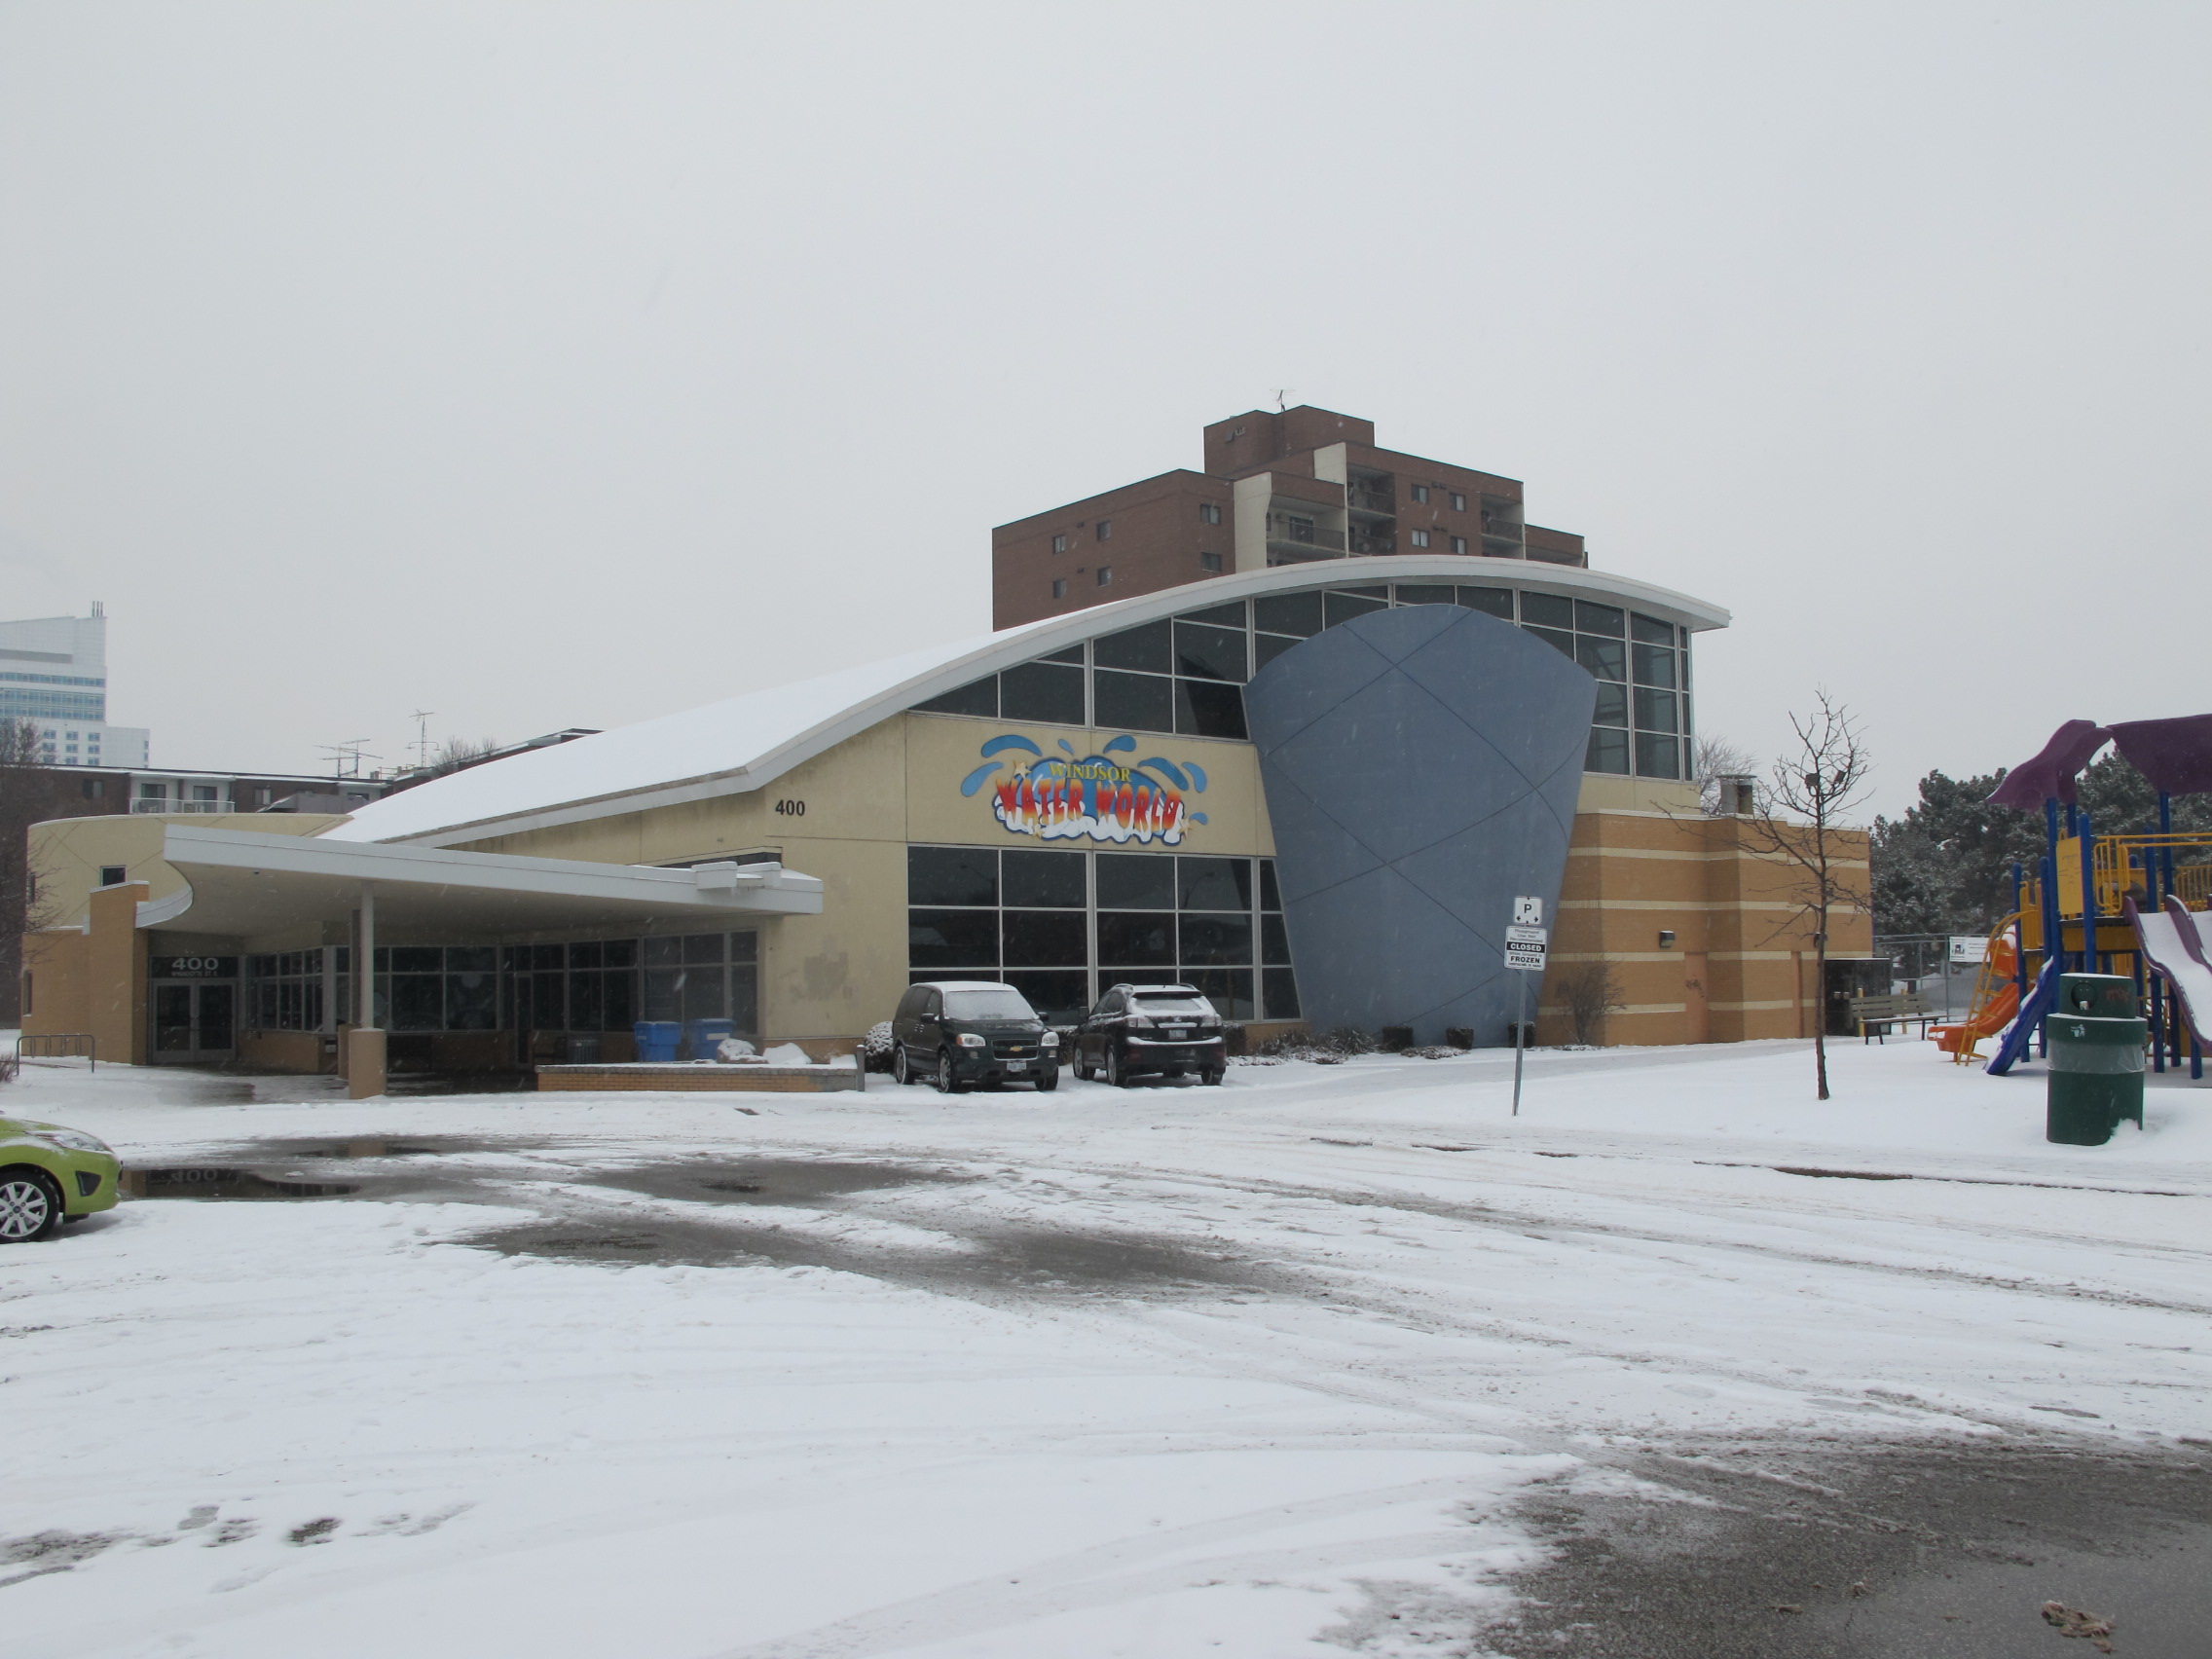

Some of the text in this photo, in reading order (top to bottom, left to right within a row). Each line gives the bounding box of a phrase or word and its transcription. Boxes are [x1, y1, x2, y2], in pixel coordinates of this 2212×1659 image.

[1049, 762, 1131, 783] WINDSOR
[775, 799, 805, 816] 400
[996, 778, 1182, 832] WATER WORLD
[1524, 903, 1532, 913] P
[1510, 942, 1541, 951] CLOSED
[171, 957, 219, 970] 400
[1510, 955, 1540, 964] FROZEN
